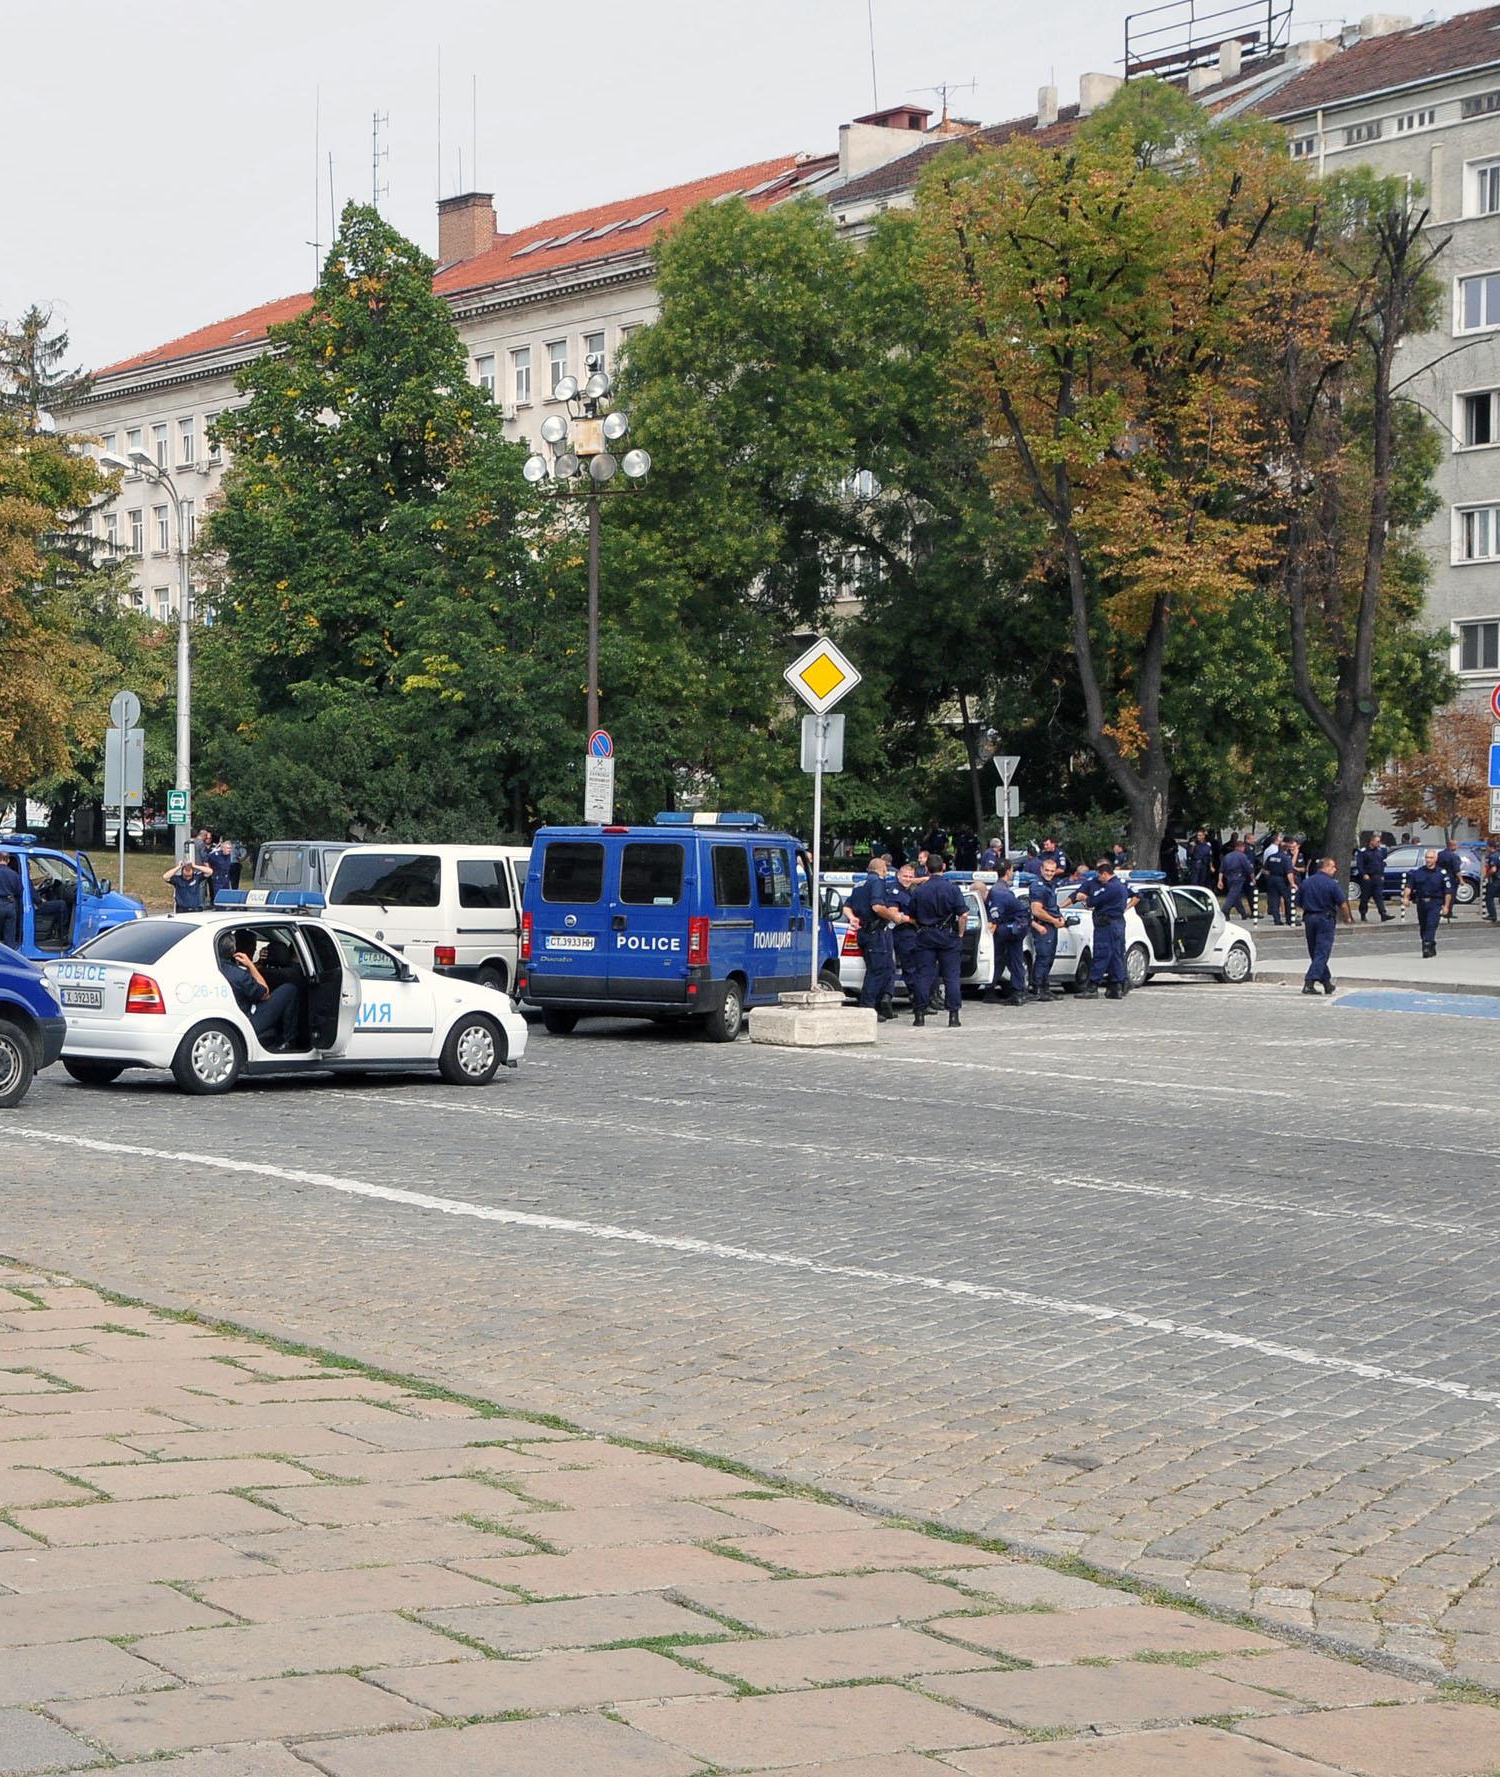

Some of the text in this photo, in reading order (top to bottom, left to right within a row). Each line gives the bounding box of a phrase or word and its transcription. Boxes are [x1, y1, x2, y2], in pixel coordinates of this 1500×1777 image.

[616, 936, 680, 951] POLICE
[753, 931, 792, 951] ПОЛИЦИЯ
[57, 964, 107, 981] POLICE
[194, 985, 229, 998] 26-18
